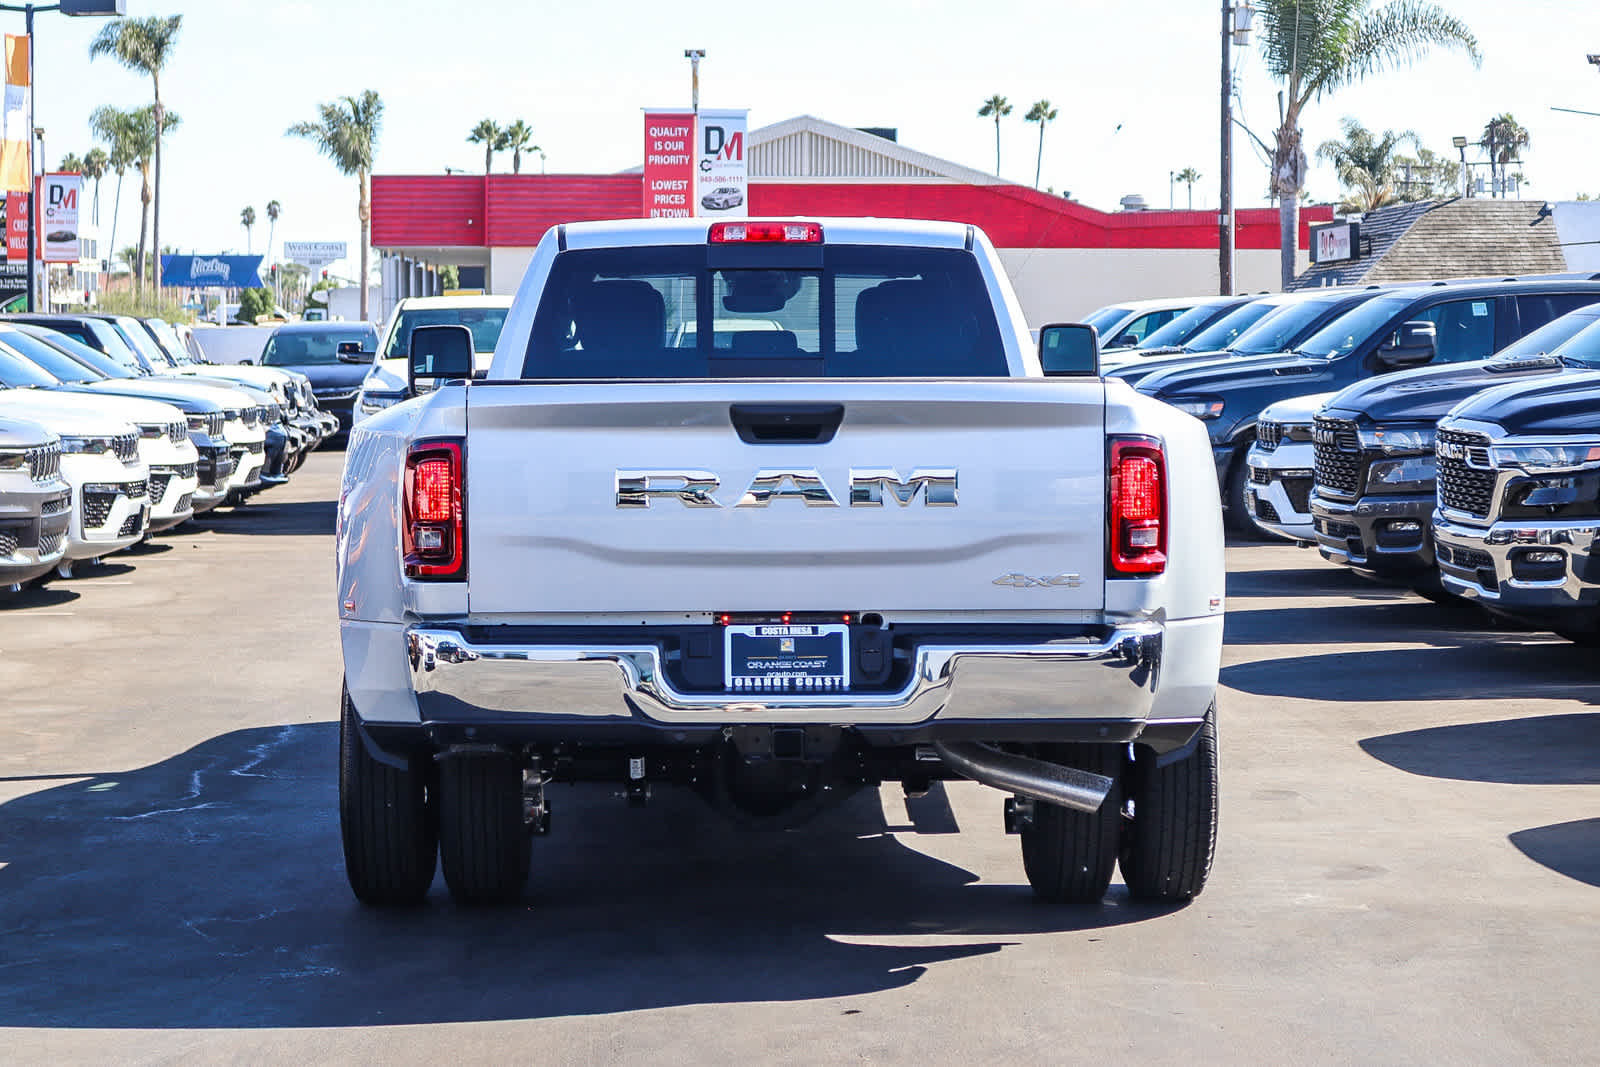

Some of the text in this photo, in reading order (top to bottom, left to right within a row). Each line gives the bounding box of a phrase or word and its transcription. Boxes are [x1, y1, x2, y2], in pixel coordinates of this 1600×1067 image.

[649, 127, 689, 137] QUALITY
[654, 141, 684, 151] IS OUR
[648, 155, 690, 165] PRIORITY
[651, 180, 688, 190] LOWEST
[654, 194, 685, 204] PRICES
[650, 208, 690, 218] IN TOWN
[13, 219, 28, 232] CRED
[615, 466, 959, 509] RAM
[761, 626, 788, 635] COSTA
[747, 660, 827, 669] ORANGE COAST
[734, 677, 841, 687] ORANGE COAST
